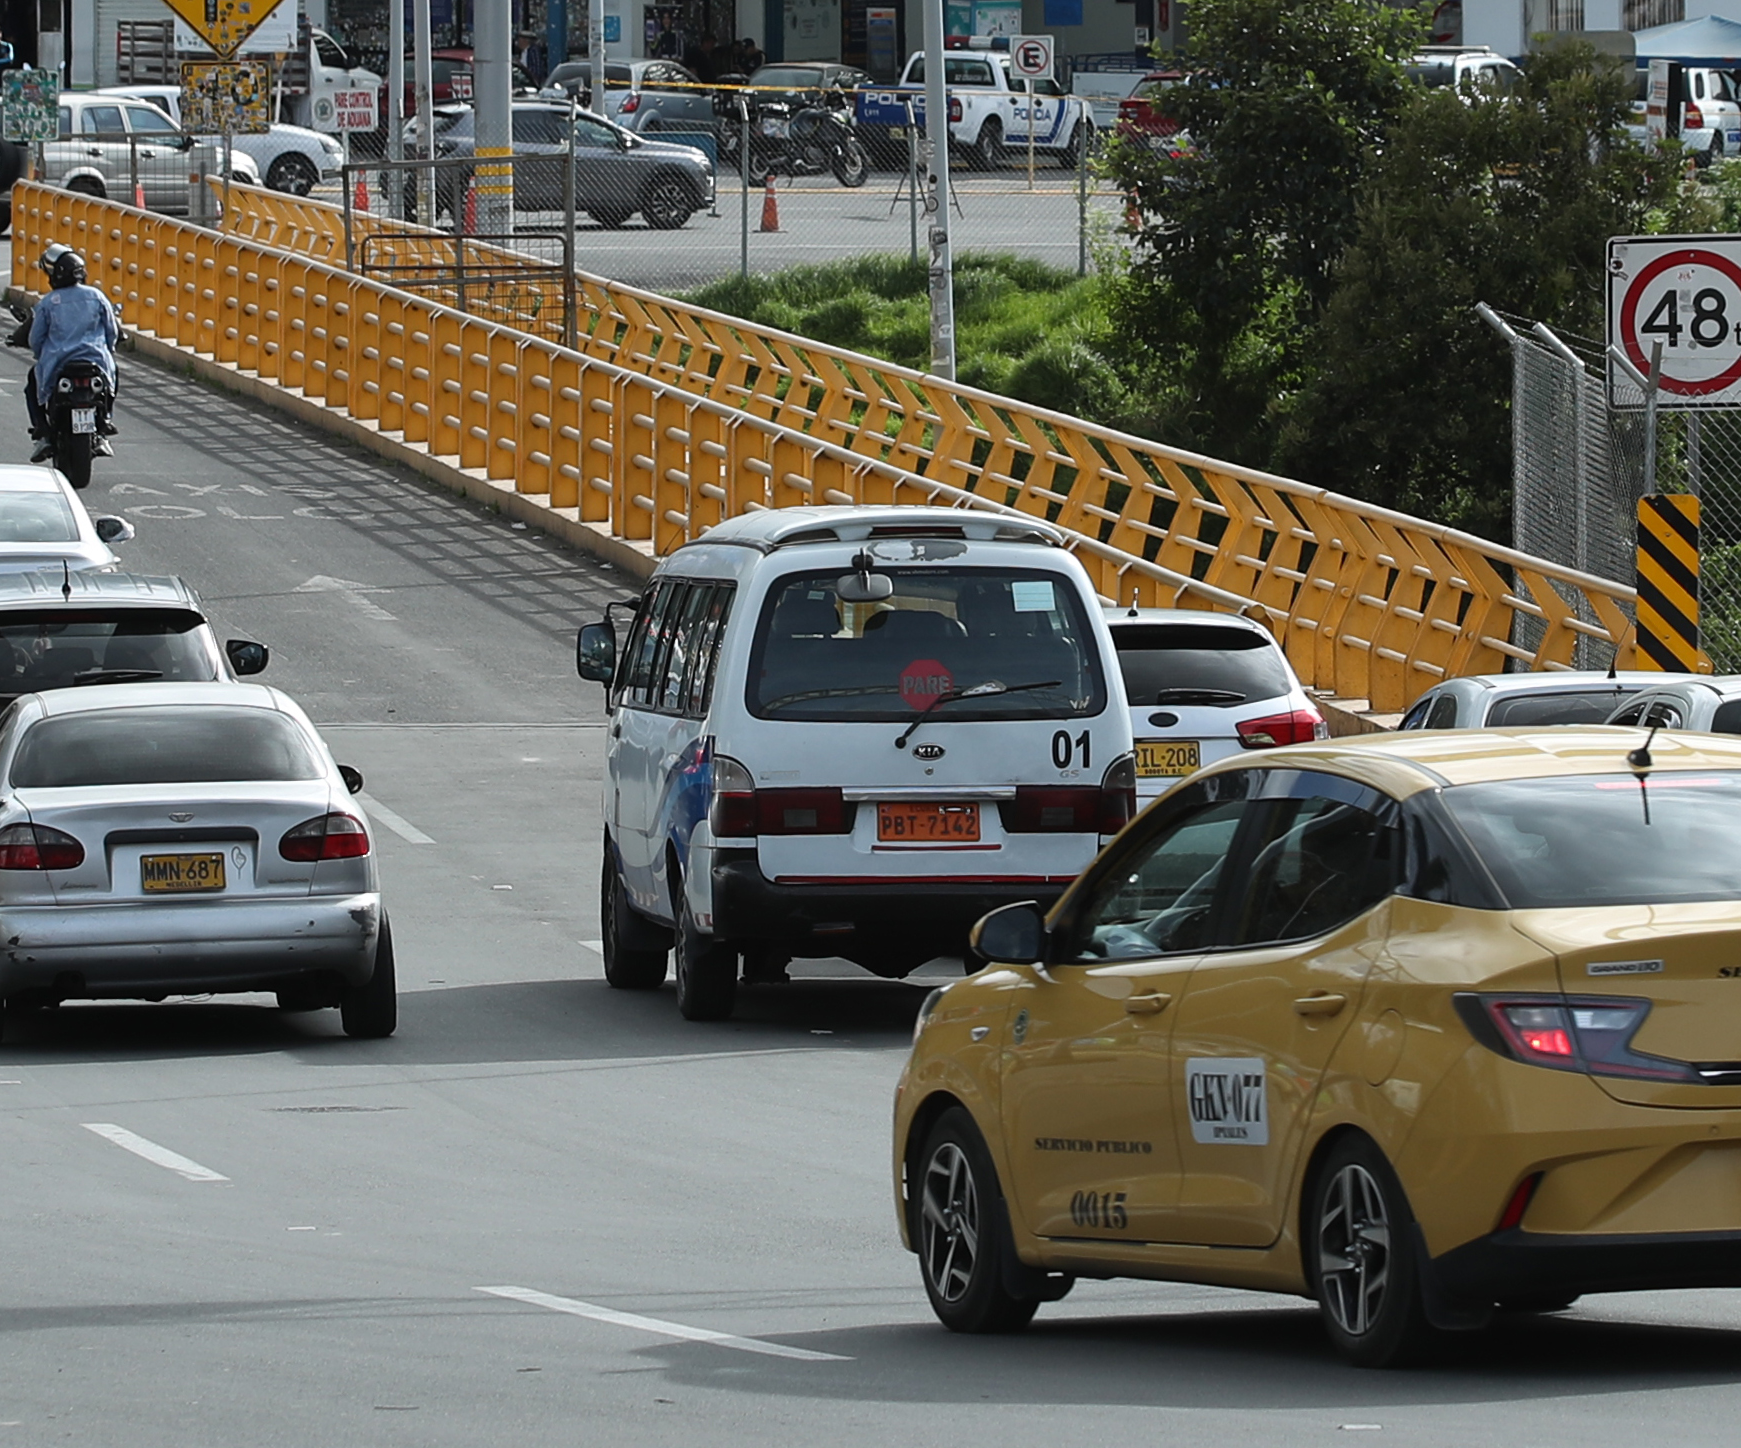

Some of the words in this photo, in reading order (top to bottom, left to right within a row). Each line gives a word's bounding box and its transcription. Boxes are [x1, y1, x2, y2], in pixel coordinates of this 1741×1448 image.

[334, 92, 347, 109] PARE
[348, 92, 373, 109] CONTROL
[337, 111, 345, 128] DE
[346, 111, 371, 128] ADUANA
[1641, 288, 1729, 348] 48
[904, 676, 950, 695] PARE
[918, 747, 940, 757] KIA
[1052, 730, 1091, 769] 01
[881, 815, 976, 836] PBT-7142
[1213, 1126, 1248, 1139] IPIALES
[1034, 1137, 1093, 1153] SERVICIO
[1097, 1139, 1152, 1154] PUBLICO
[1070, 1190, 1128, 1230] 0015
